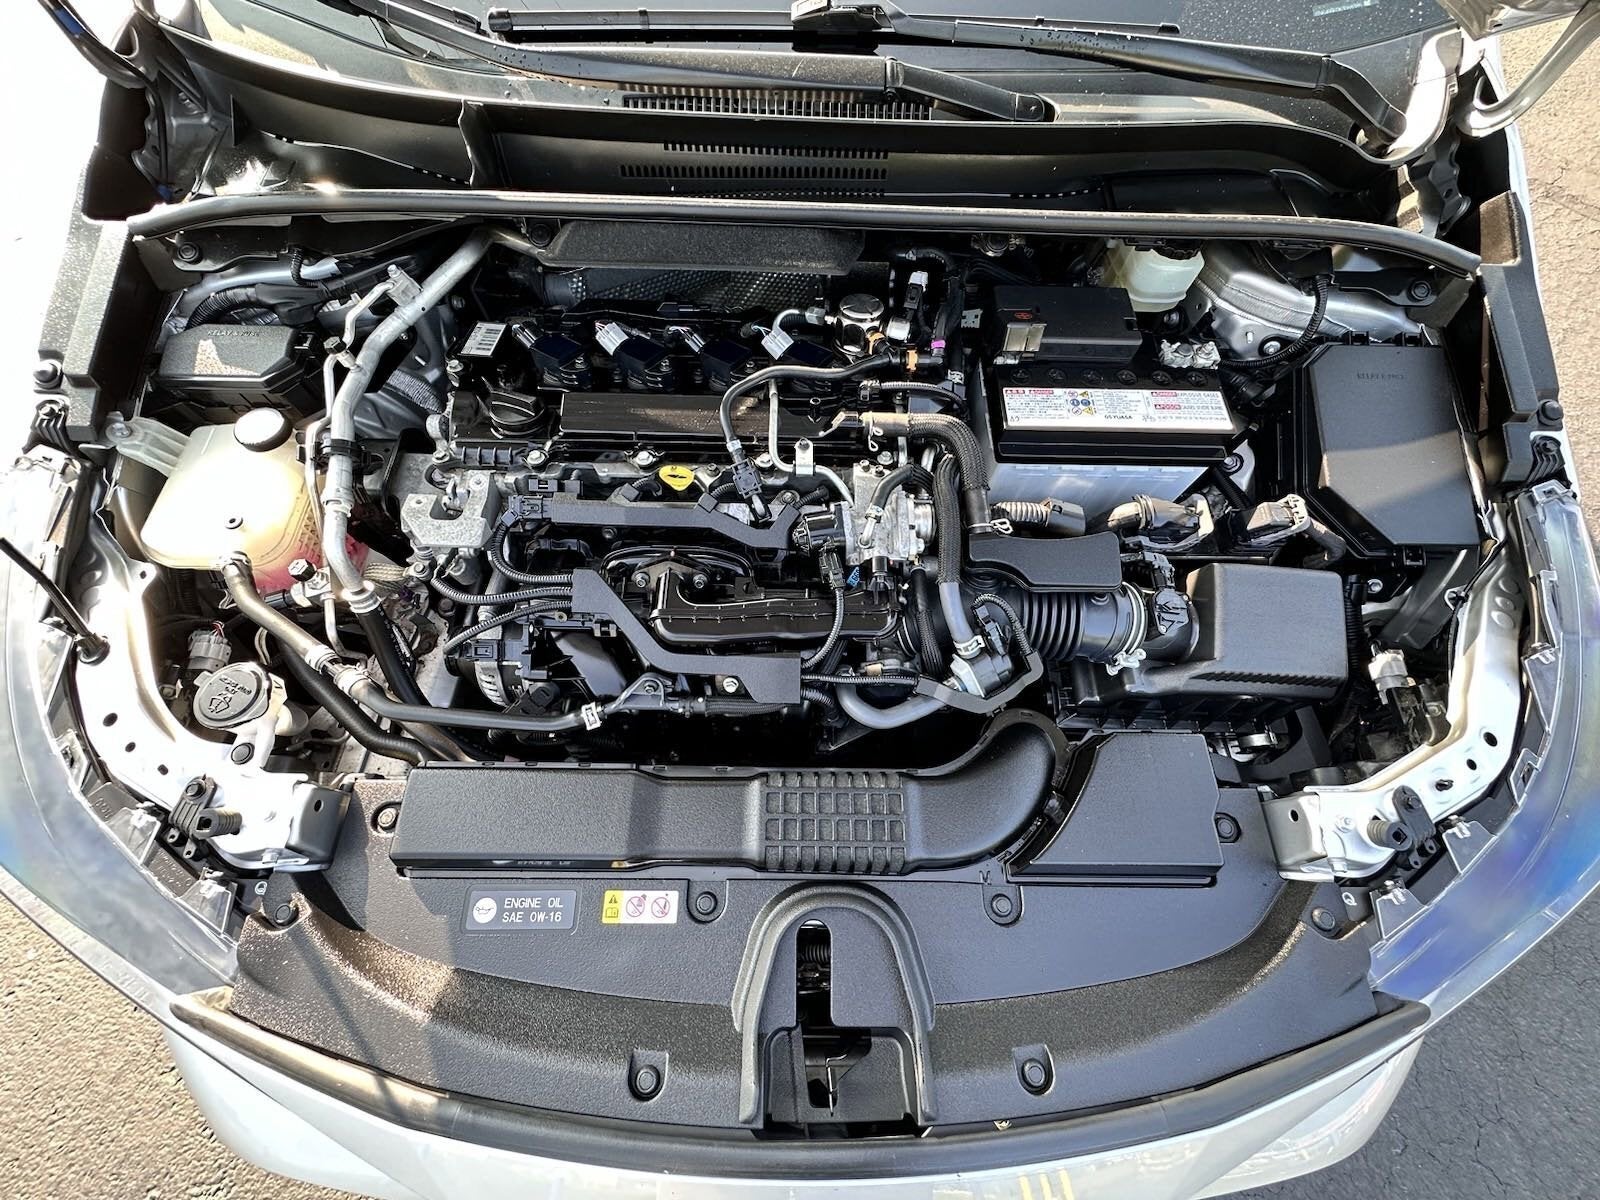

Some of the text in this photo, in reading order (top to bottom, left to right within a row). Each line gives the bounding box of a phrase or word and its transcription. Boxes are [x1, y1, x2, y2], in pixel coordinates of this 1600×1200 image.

[503, 897, 564, 909] ENGINE OIL
[502, 911, 562, 923] SAE 0W-16
